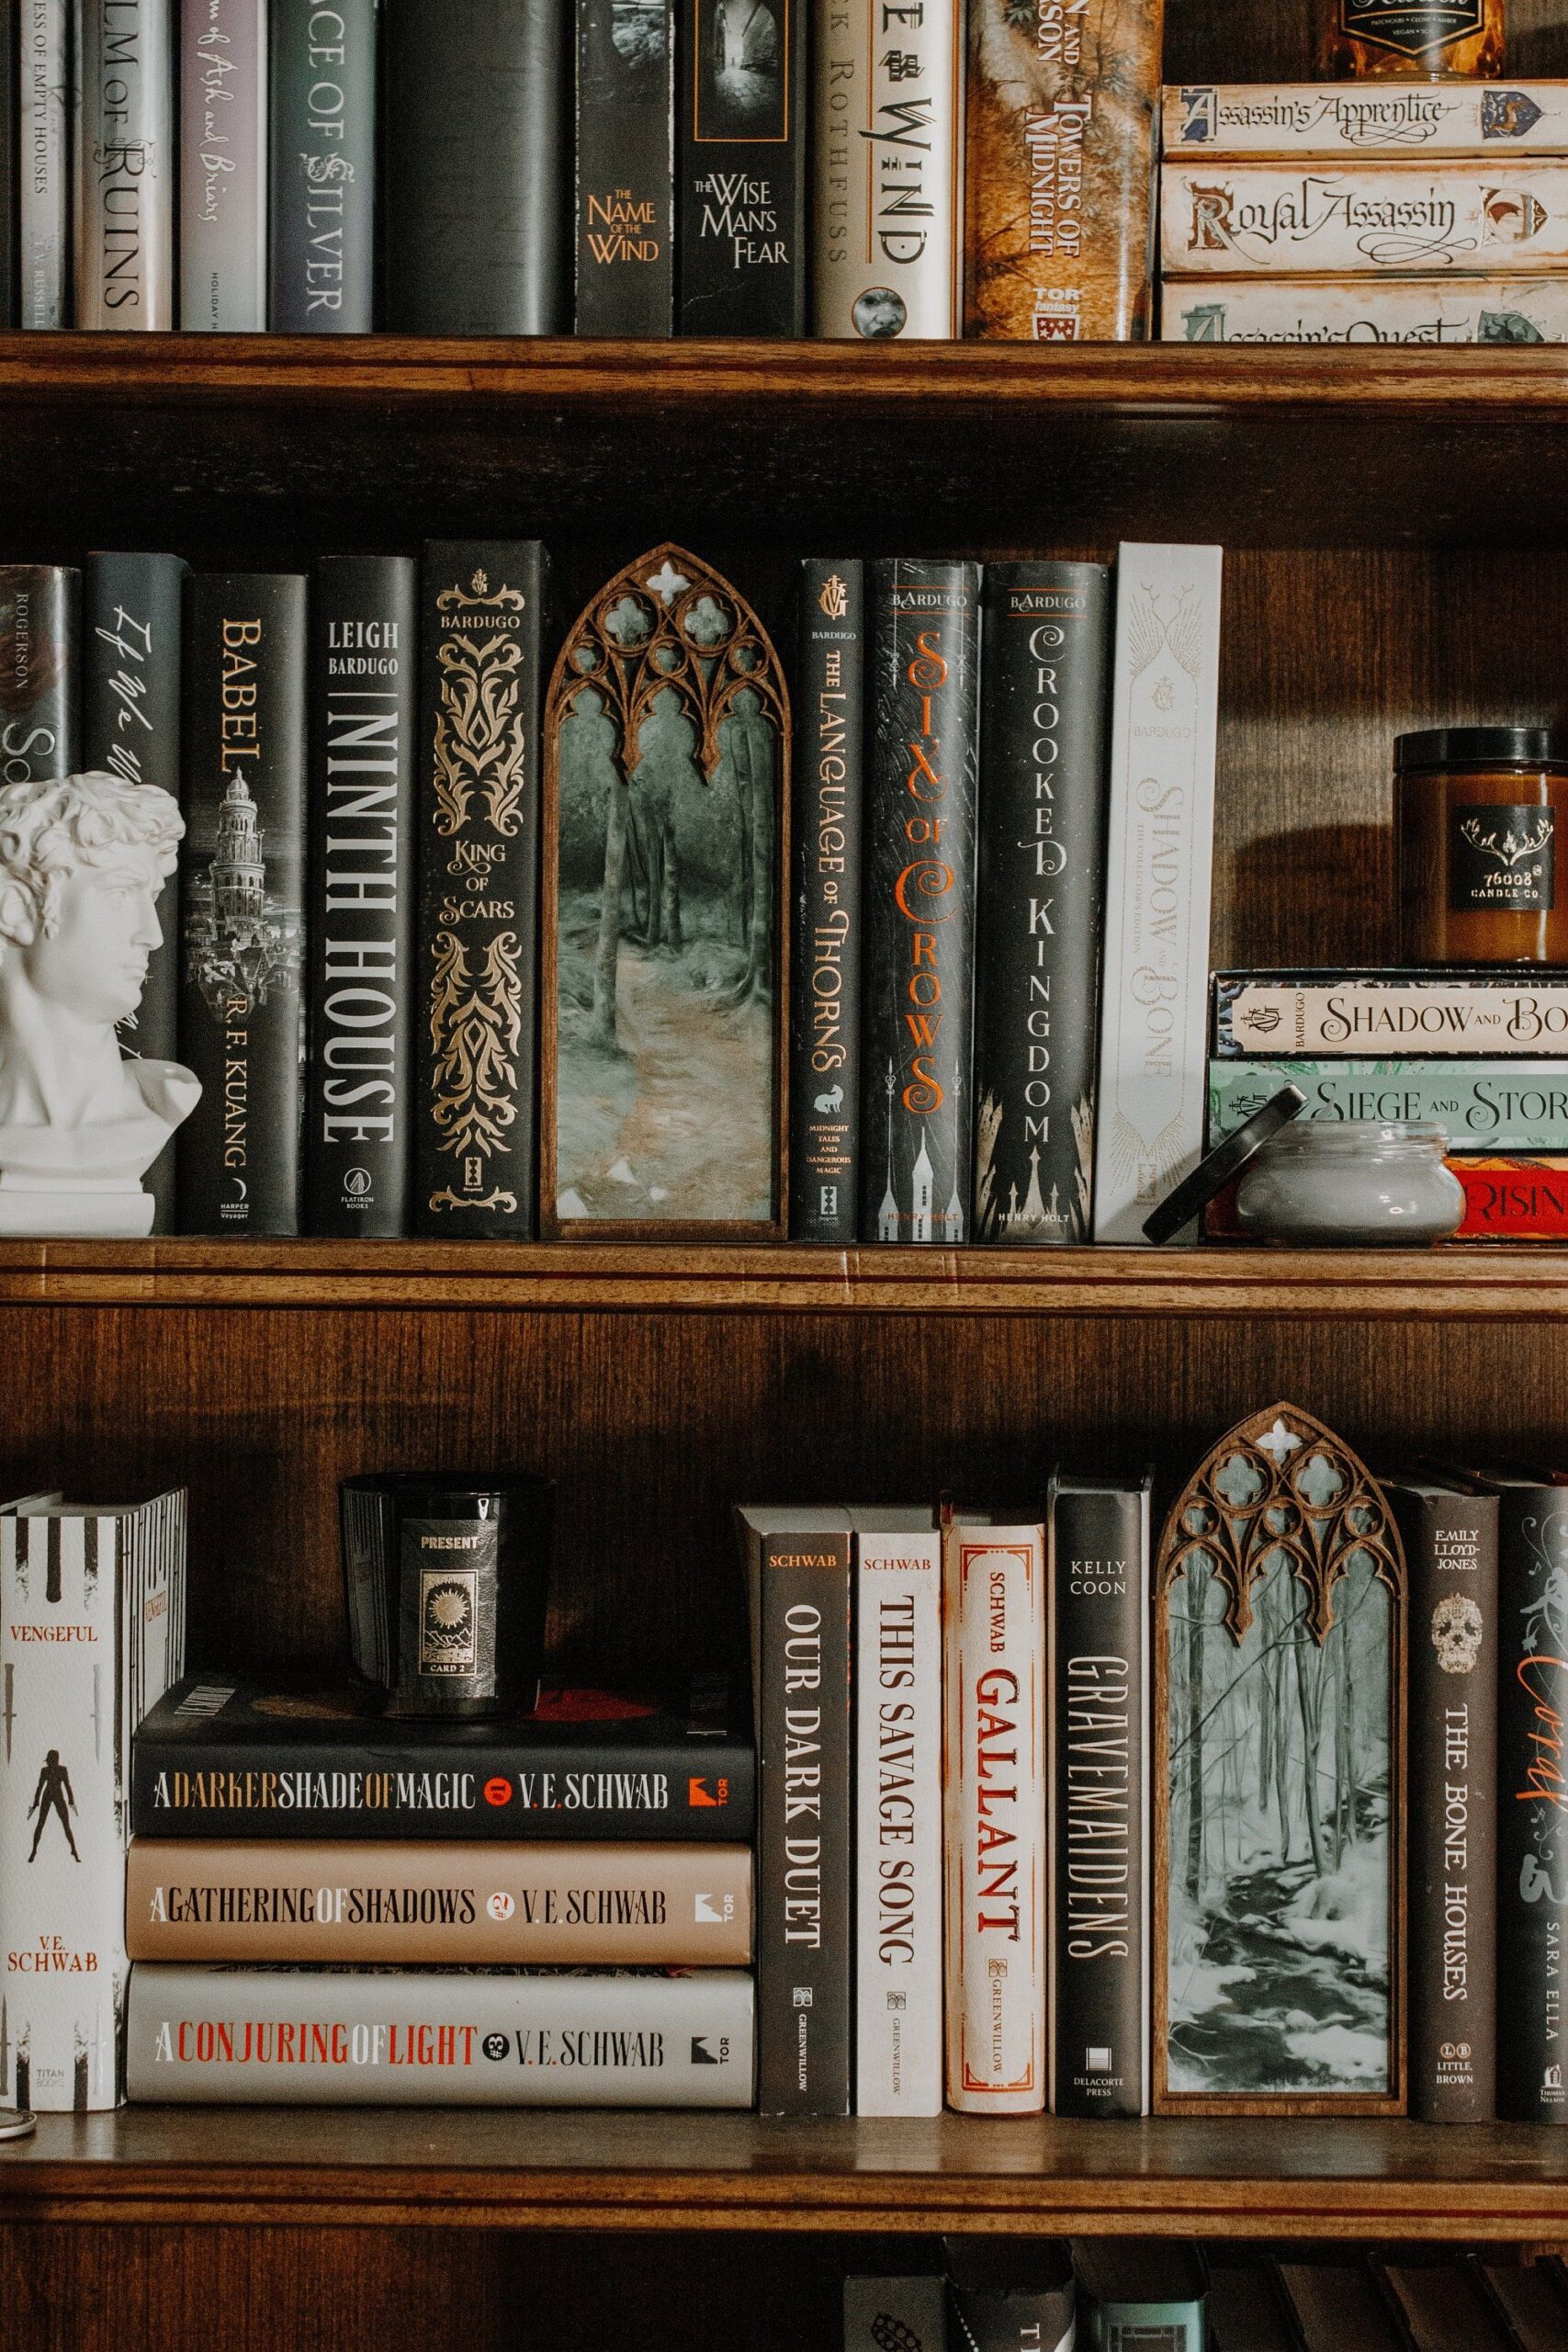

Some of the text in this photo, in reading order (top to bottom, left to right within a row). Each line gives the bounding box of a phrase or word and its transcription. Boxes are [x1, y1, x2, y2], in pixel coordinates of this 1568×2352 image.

[1064, 24, 1081, 65] AND
[34, 35, 48, 195] OF EMPTY HOUSES
[197, 26, 239, 223] of Ash and Briars
[1182, 88, 1462, 147] Assassin's Apprentice
[826, 59, 855, 264] ROTHFUSS
[1054, 93, 1092, 259] TOWERS OF
[93, 79, 156, 309] OF RUINS
[299, 82, 355, 315] OF SILVER
[614, 189, 632, 199] THE
[694, 173, 772, 207] THE WISE
[1023, 111, 1060, 258] MIDNIGHT
[587, 195, 657, 225] NAME
[700, 205, 778, 238] MAN'S
[1185, 176, 1478, 265] Royal Assassin
[611, 223, 642, 234] OF THE
[588, 233, 660, 265] WIND
[734, 236, 790, 269] FEAR
[1033, 288, 1080, 301] TOR
[1034, 301, 1080, 314] fantasy
[892, 590, 968, 610] BARDUGO
[1010, 592, 1087, 613] BARDUGO
[96, 605, 152, 662] If
[328, 621, 400, 650] LEIGH
[440, 615, 522, 629] BARDUGO
[811, 631, 858, 641] BARDUGO
[16, 594, 28, 689] ROGERSON
[328, 657, 400, 675] BARDUGO
[220, 617, 263, 773] BABEL
[1134, 725, 1190, 739] BARDUGO
[446, 839, 507, 876] KING
[810, 650, 851, 1073] THE LANGUAGE OF THORNS
[894, 631, 957, 1114] SIX OF CROWS
[466, 877, 489, 892] OF
[1017, 624, 1068, 1144] CROOKED KINGDOM
[1471, 888, 1543, 899] CANDLE CO.
[1484, 871, 1532, 888] 76008
[439, 896, 516, 927] SCARS
[1133, 844, 1145, 955] COLLECTOR'S EDITION
[323, 710, 400, 1143] NINTH HOUSE
[1130, 777, 1185, 1079] SHADOW BONE
[1295, 992, 1305, 1048] BARDUGO
[1320, 997, 1501, 1042] SHADOW AND
[224, 998, 248, 1169] R. F. KUANG
[1311, 1081, 1422, 1121] SIEGE
[1429, 1102, 1459, 1112] AND
[808, 1125, 851, 1133] MIDNIGHT
[818, 1135, 840, 1143] TALES
[806, 1156, 852, 1164] DANGEROUS
[820, 1145, 839, 1154] AND
[816, 1166, 842, 1175] MAGIC
[220, 1212, 249, 1220] Voyager
[886, 1212, 960, 1222] HENRY HOLT
[998, 1213, 1070, 1223] HENRY HOLT
[421, 1536, 479, 1550] PRESENT
[1434, 1544, 1481, 1557] LLOYD-
[1435, 1530, 1479, 1542] EMILY
[769, 1555, 838, 1567] SCHWAB
[863, 1558, 931, 1571] SCHWAB
[1071, 1561, 1126, 1574] KELLY
[1437, 1558, 1478, 1570] JONES
[1070, 1581, 1127, 1595] COON
[989, 1571, 1006, 1654] SCHWAB
[10, 1624, 98, 1643] VENGEFUL
[430, 1664, 466, 1673] CARD 2
[564, 1773, 669, 1809] SCHWAB
[784, 1604, 821, 1949] OUR DARK DUET
[878, 1594, 915, 1967] THIS SAVAGE SONG
[717, 1778, 729, 1806] TOR
[976, 1668, 1021, 1942] GALLANT
[1067, 1656, 1130, 1959] GRAVEMAIDENS
[1443, 1702, 1468, 2002] THE BONE HOUSES
[565, 1890, 667, 1925] SCHWAB
[724, 1894, 734, 1922] TOR
[7, 1951, 99, 1973] SCHWAB
[1546, 1922, 1560, 2041] SARA ELLA
[992, 1978, 1003, 2074] GREENWILLOW
[559, 2030, 665, 2067] SCHWAB
[720, 2036, 730, 2064] TOR
[797, 2013, 808, 2092] GREENWILLOW
[892, 2018, 900, 2096] GREENWILLOW
[37, 2068, 64, 2077] TITAN
[1074, 2077, 1124, 2086] DELACORTE
[1436, 2075, 1474, 2085] BROWN
[1437, 2062, 1473, 2073] LITTLE,
[1086, 2087, 1111, 2097] PRESS
